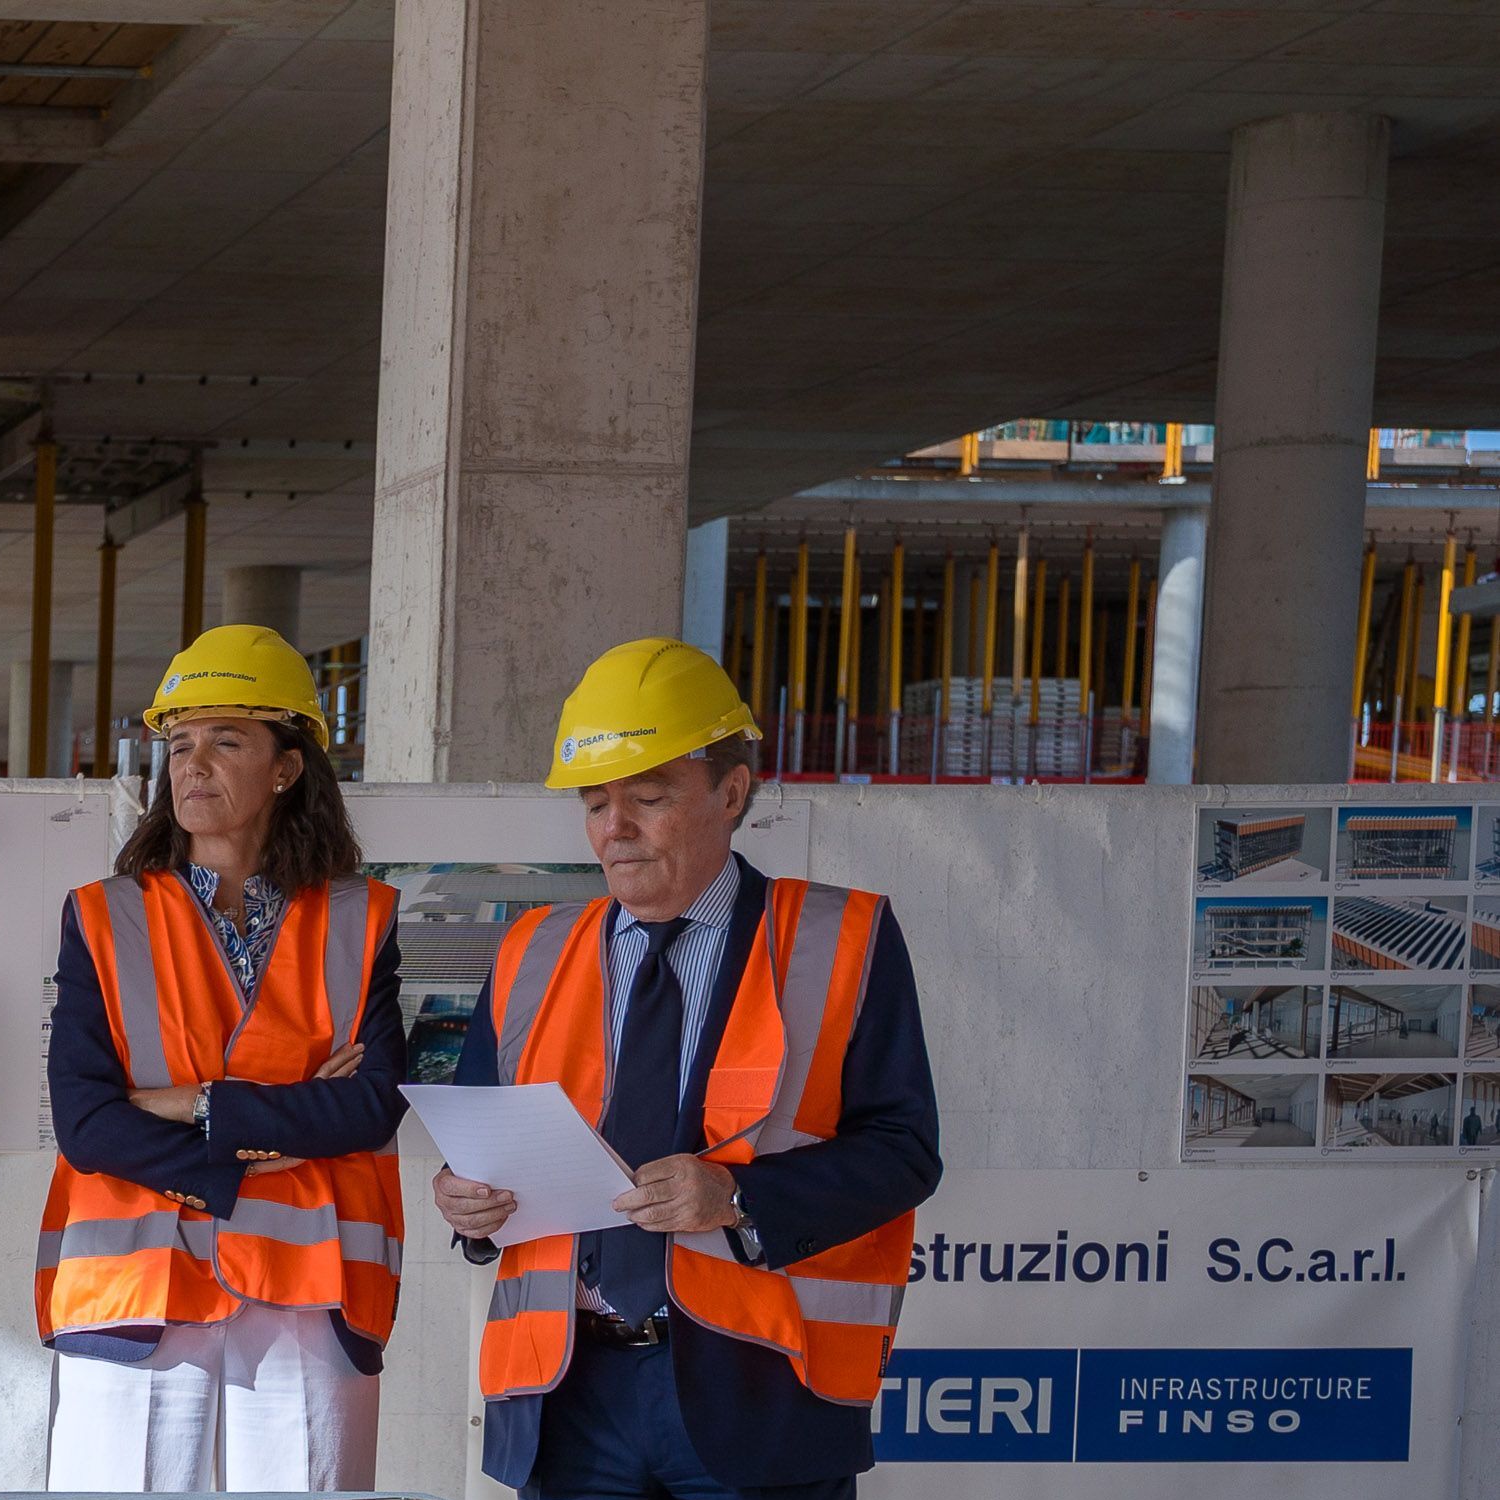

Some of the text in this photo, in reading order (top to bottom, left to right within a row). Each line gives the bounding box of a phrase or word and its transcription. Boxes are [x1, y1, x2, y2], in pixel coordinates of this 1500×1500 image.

[181, 671, 257, 683] CISAR Costruzioni
[577, 727, 657, 748] CISAR Costruzioni
[1206, 1237, 1406, 1283] S.C.a.r.l.
[1120, 1377, 1372, 1400] INFRASTRUCTURE
[1118, 1409, 1301, 1433] FINSO
